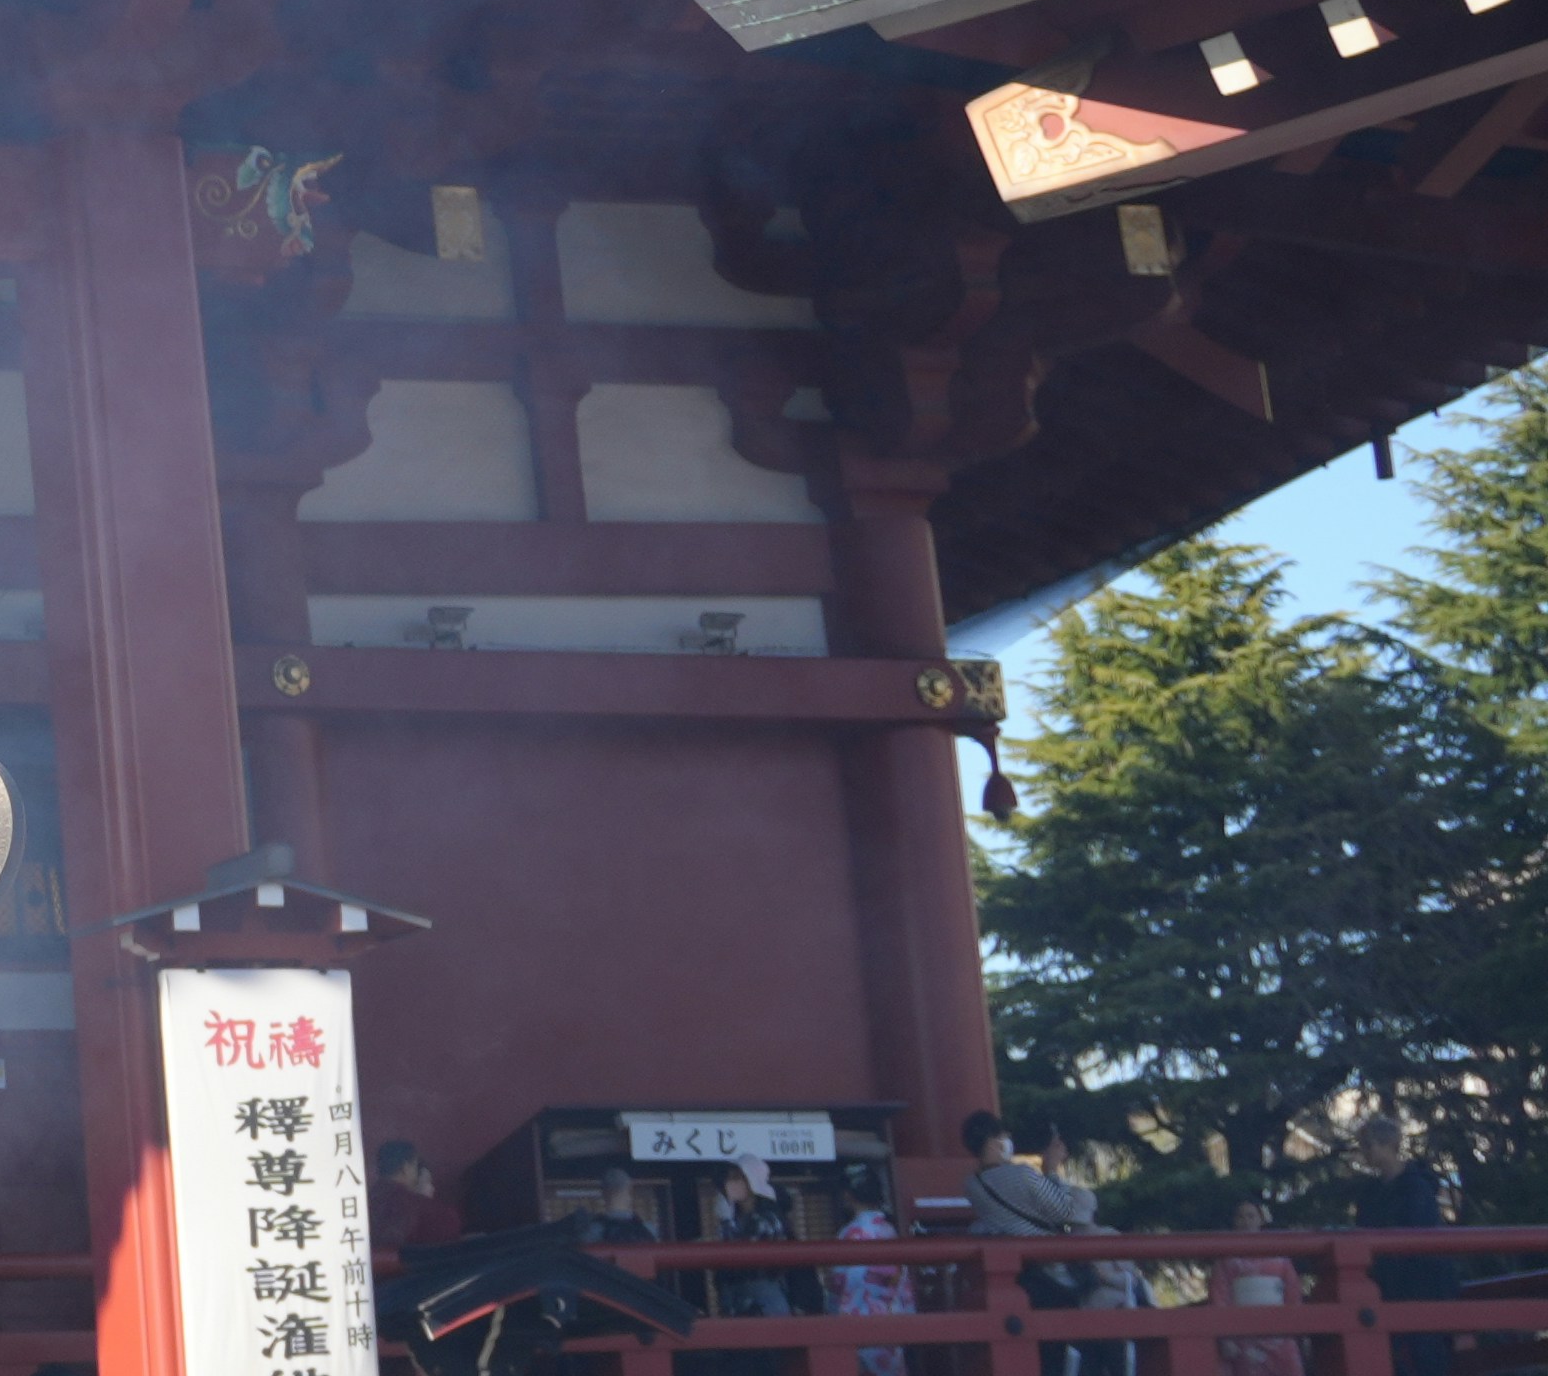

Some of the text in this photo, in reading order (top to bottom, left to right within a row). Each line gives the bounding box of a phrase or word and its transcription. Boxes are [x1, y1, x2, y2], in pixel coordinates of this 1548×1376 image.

[652, 1127, 738, 1156] みくじ
[328, 1100, 374, 1352] 四月八日午前十時
